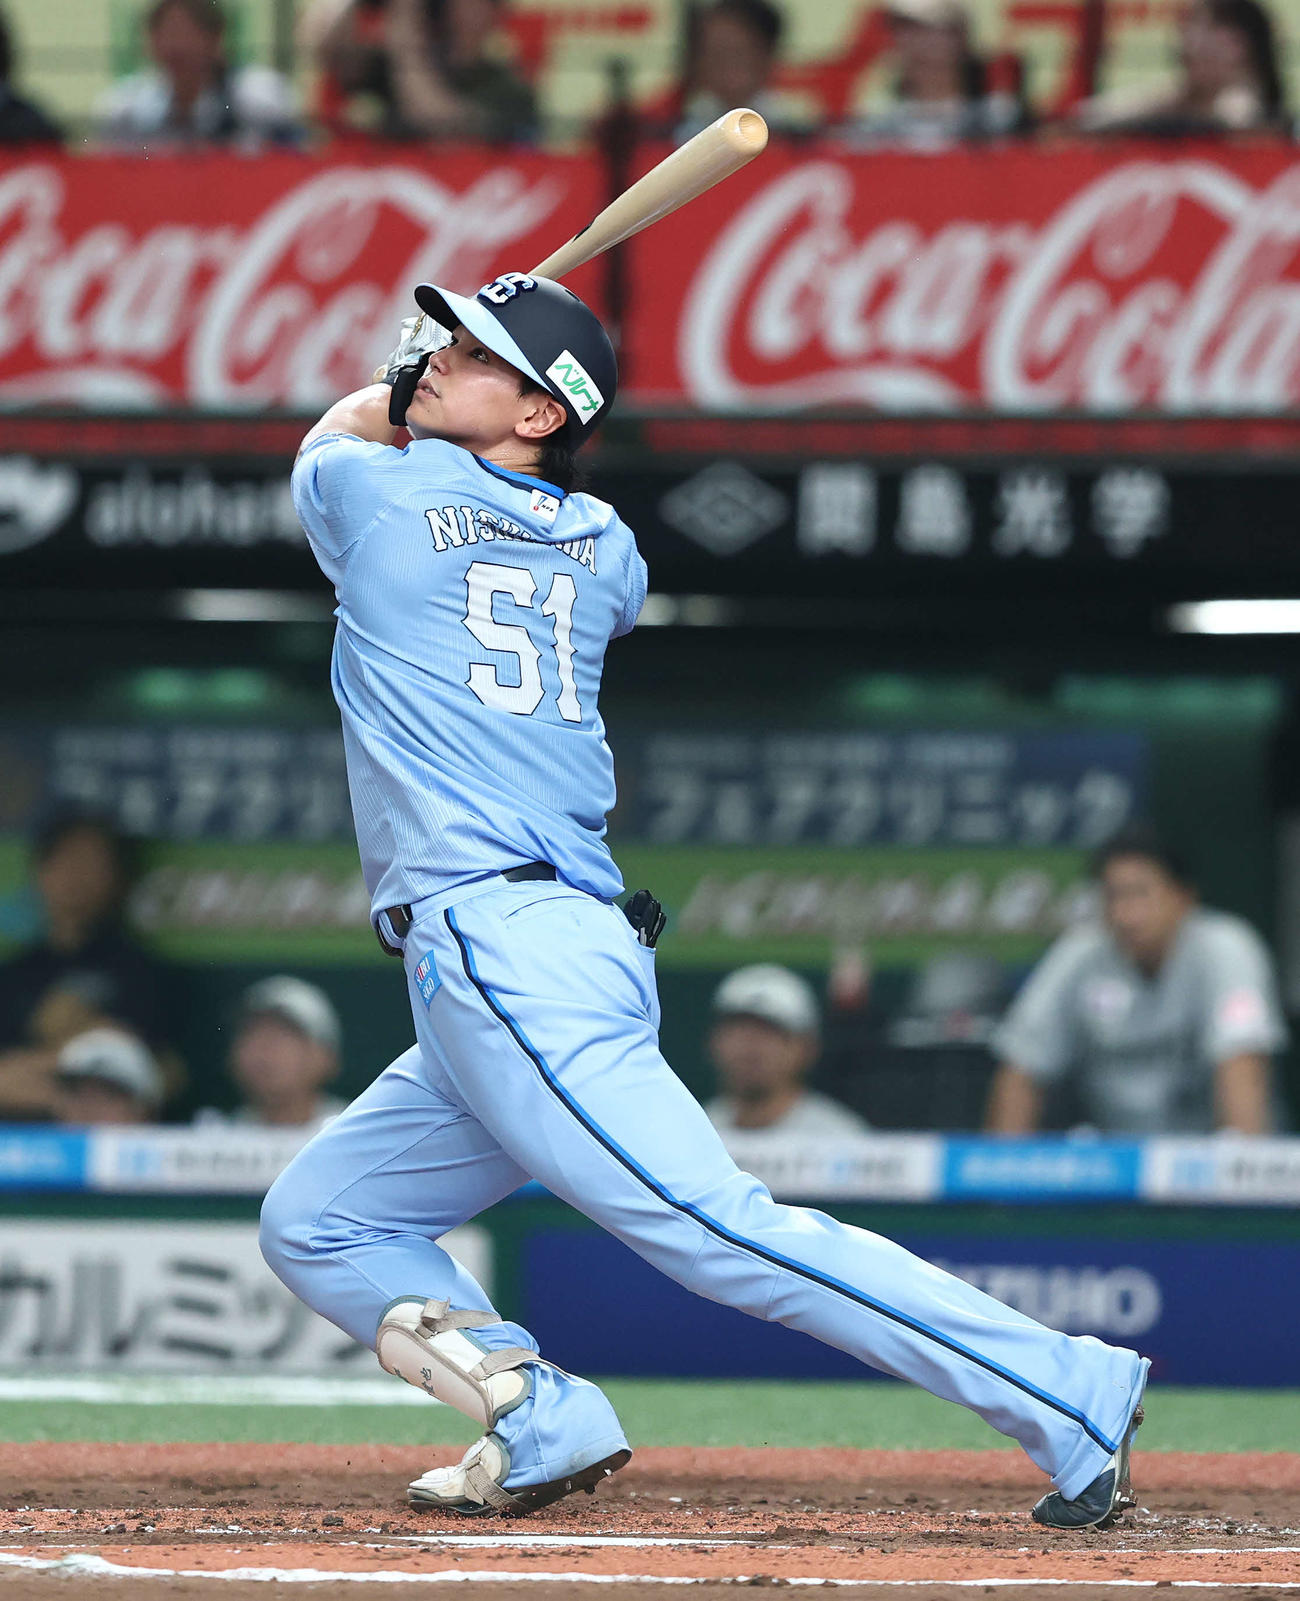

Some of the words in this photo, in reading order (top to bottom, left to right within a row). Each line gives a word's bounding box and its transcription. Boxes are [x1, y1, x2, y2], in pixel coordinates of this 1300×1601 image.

[461, 561, 582, 723] 51
[0, 1256, 372, 1362] カルミッ
